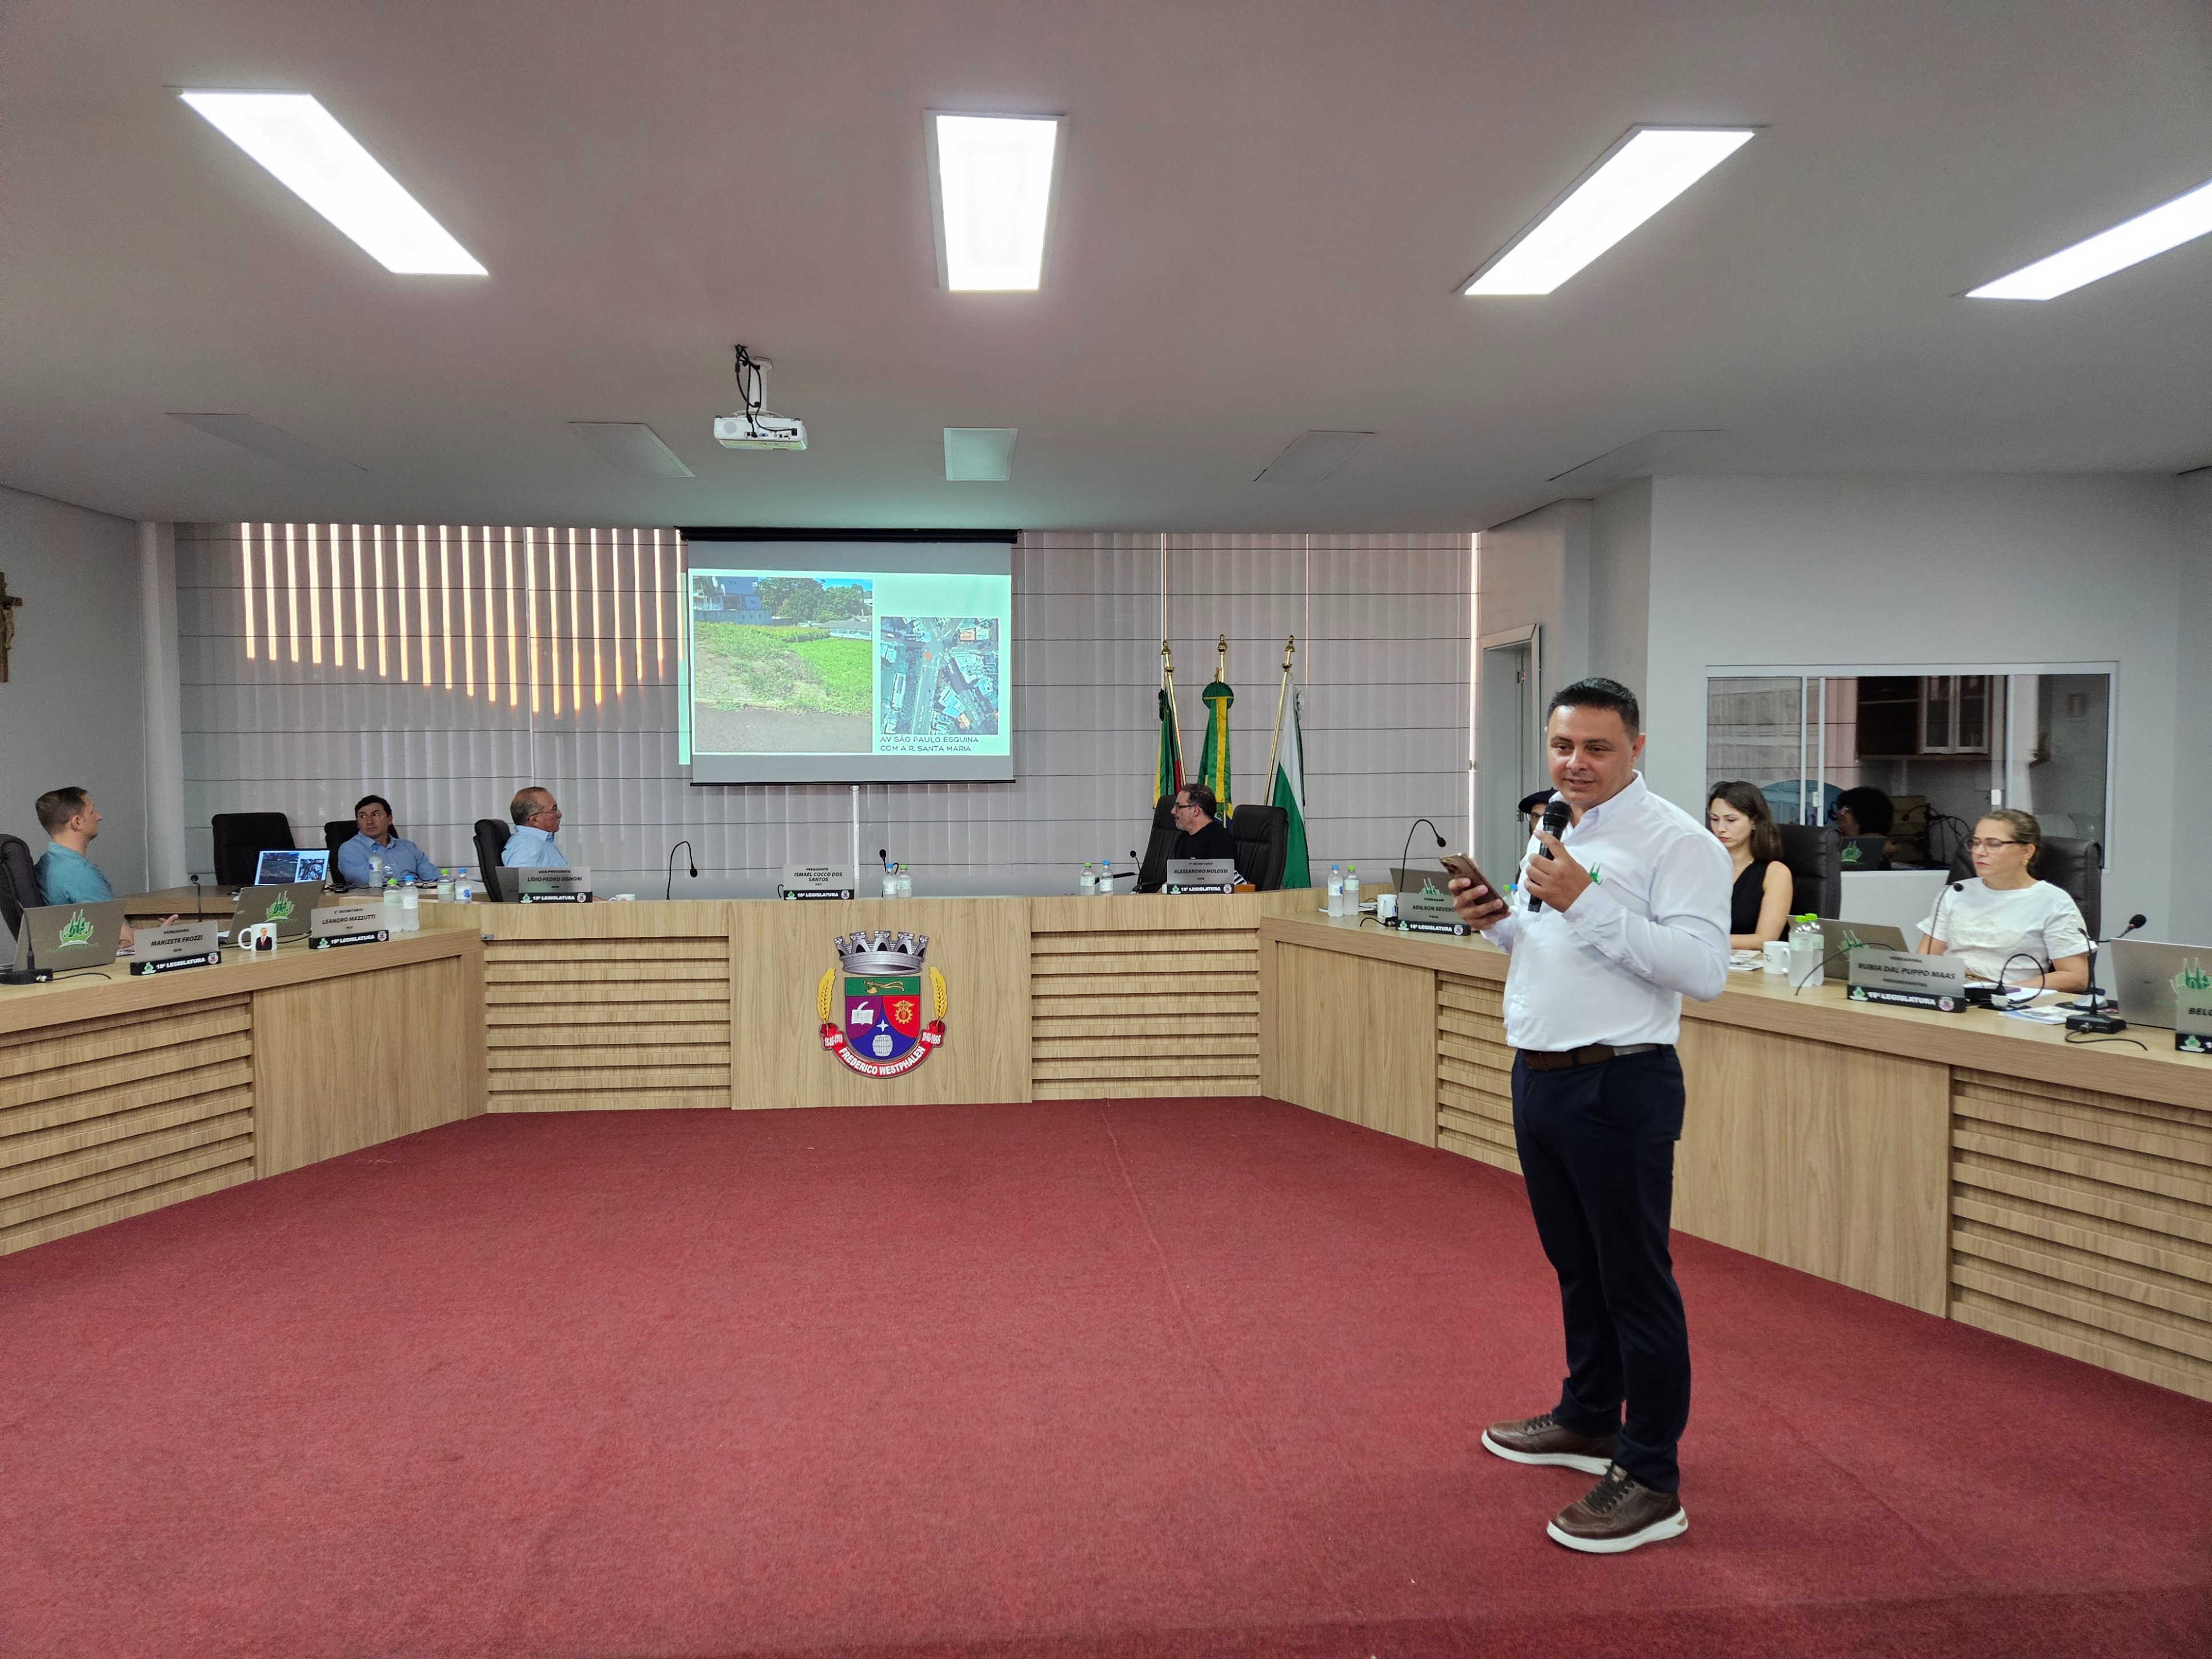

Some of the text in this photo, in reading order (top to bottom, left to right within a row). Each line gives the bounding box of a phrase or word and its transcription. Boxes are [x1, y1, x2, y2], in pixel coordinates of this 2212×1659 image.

[151, 938, 182, 947] MARIZETE
[340, 935, 375, 943] LEGISLATURA
[166, 957, 206, 968] LEGISLATURA
[1901, 968, 1929, 976] PUPPO
[1881, 992, 1936, 1006] LEGISLATURA
[839, 1045, 926, 1075] FREDERICO WESTPHALEN
